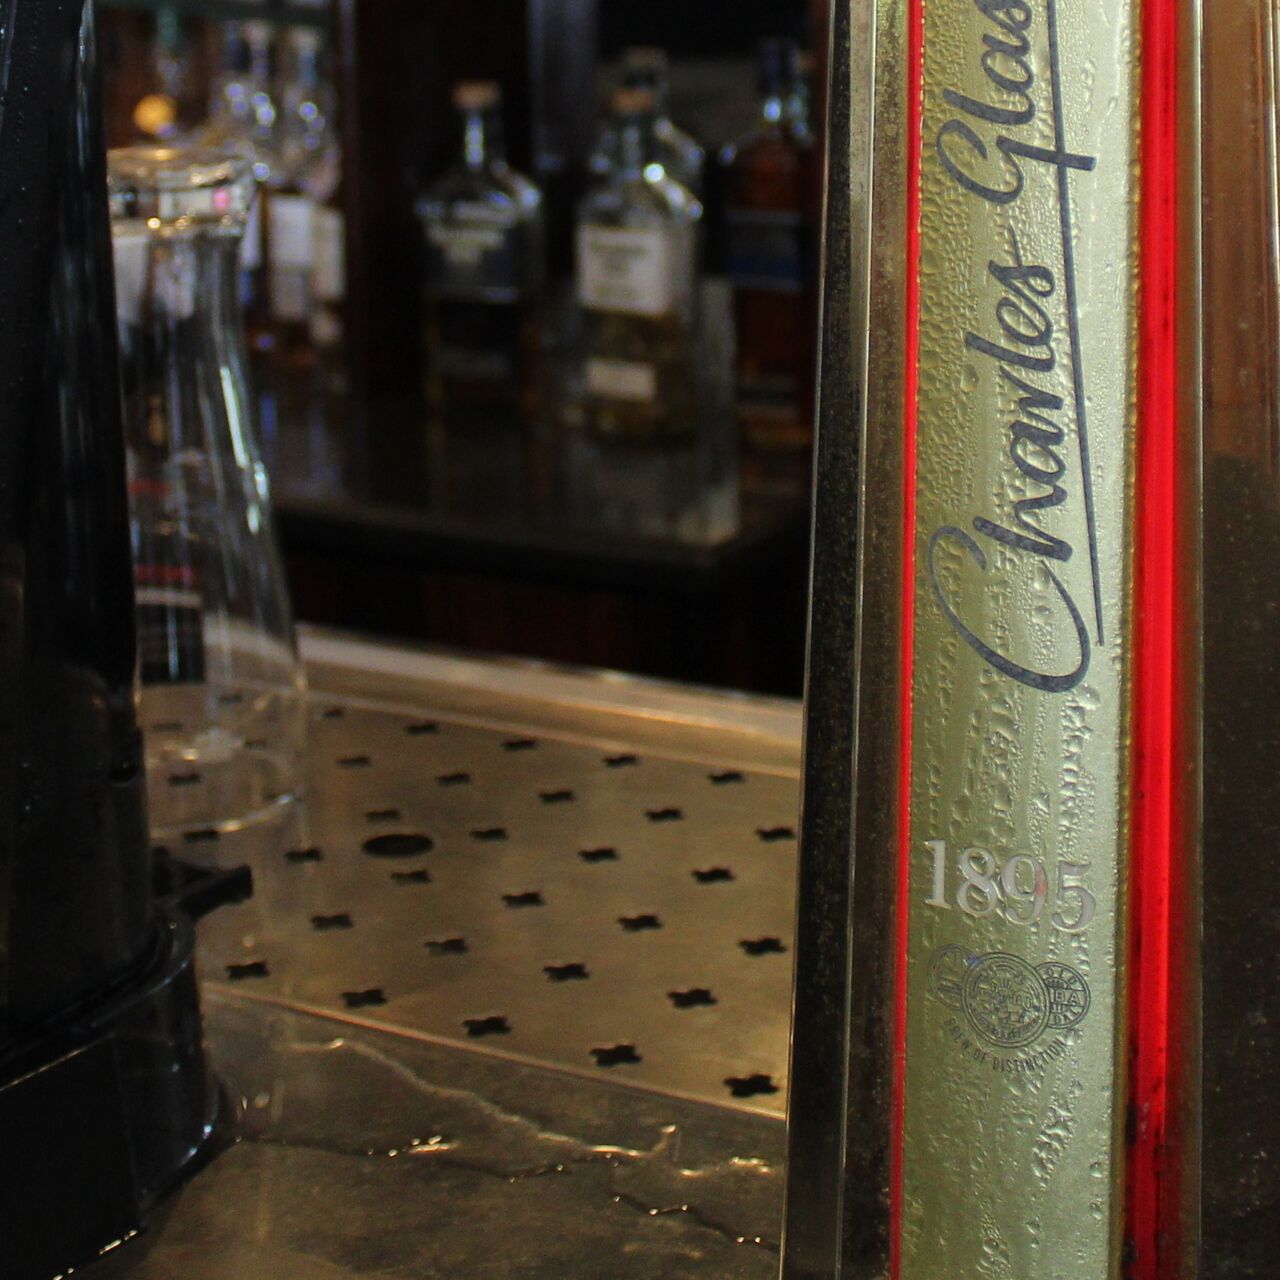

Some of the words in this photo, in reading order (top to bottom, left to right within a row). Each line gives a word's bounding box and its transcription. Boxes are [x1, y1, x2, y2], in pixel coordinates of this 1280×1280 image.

[930, 223, 1093, 694] Charles
[924, 839, 1097, 932] 1895
[973, 1049, 990, 1065] OF
[992, 1036, 1069, 1073] DISTINCTION
